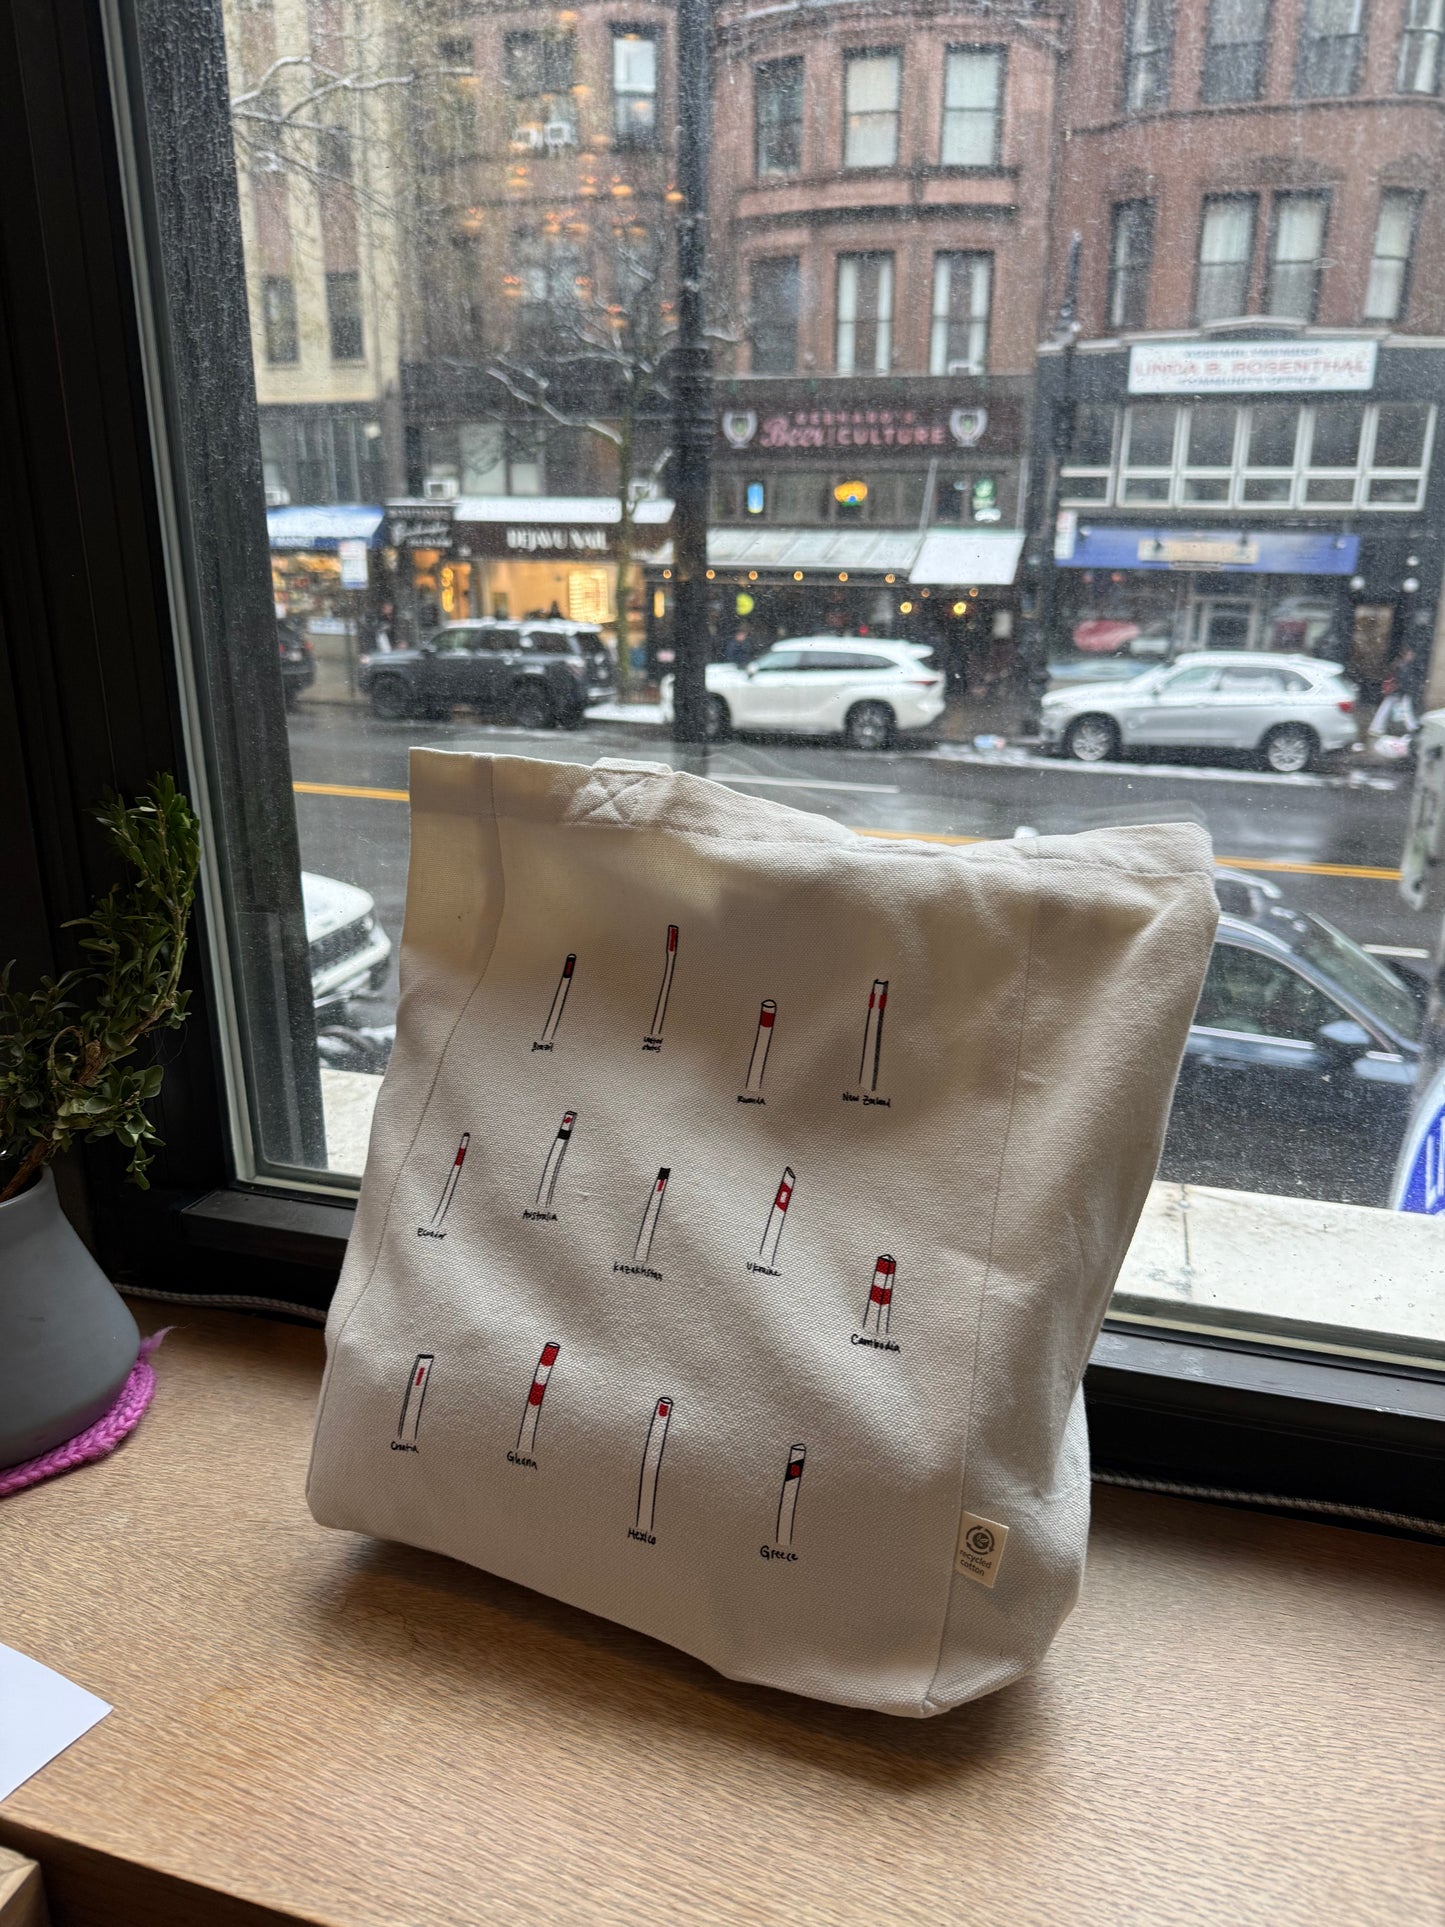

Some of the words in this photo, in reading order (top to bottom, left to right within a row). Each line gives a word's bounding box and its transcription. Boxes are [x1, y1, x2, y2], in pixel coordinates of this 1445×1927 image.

[836, 427, 946, 445] CULTURE
[842, 1092, 860, 1102] New
[850, 1333, 901, 1353] Cambodia
[506, 1451, 538, 1470] Ghana
[627, 1527, 657, 1545] Mexico
[759, 1545, 798, 1562] Greece
[959, 1549, 992, 1569] recycled
[960, 1558, 985, 1576] cotton
